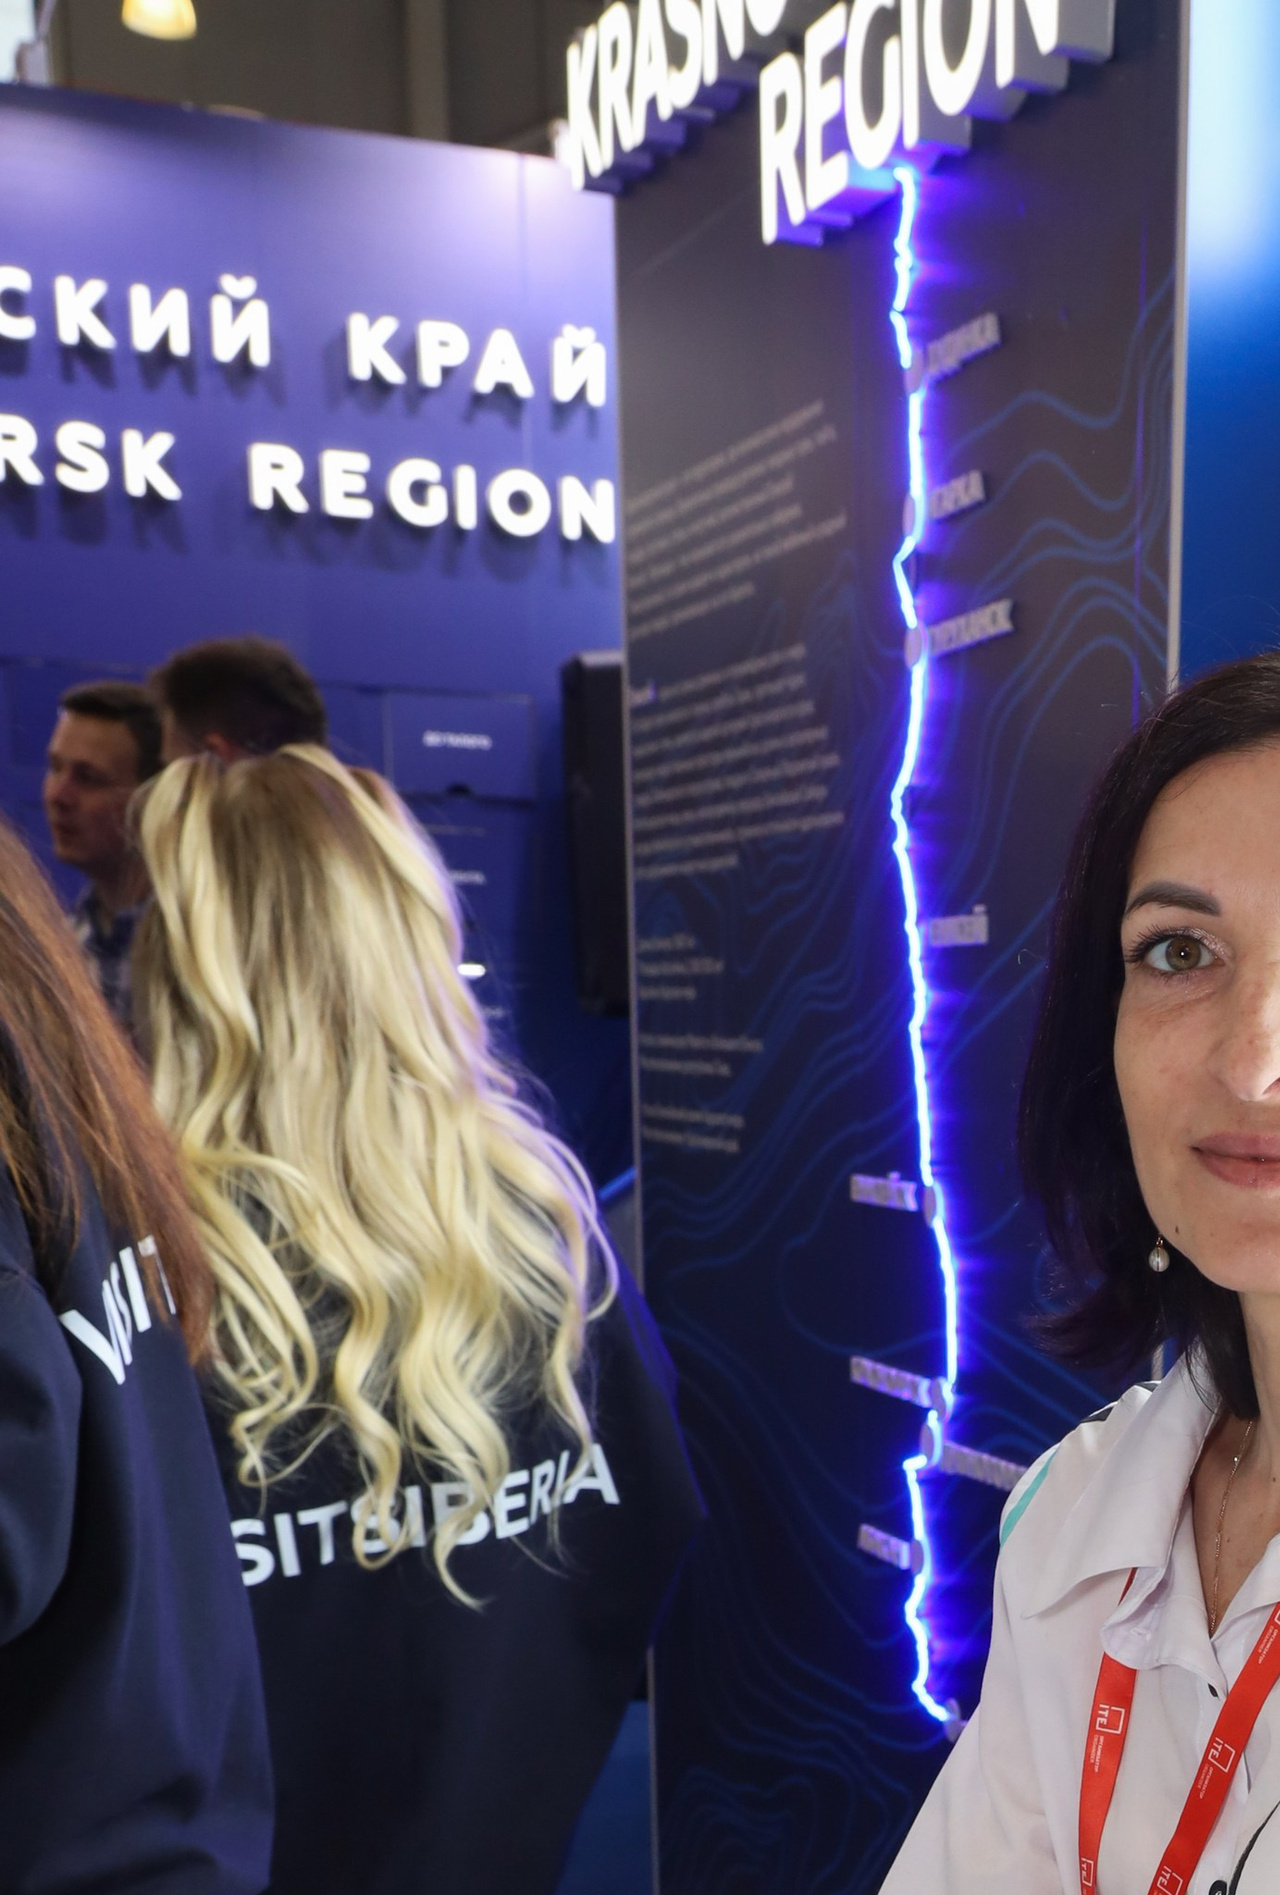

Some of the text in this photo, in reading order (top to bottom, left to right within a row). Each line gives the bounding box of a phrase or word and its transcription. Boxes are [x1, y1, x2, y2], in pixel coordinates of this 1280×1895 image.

[566, 0, 786, 190] KRASN
[347, 312, 608, 408] КРАЙ
[247, 441, 616, 545] REGION
